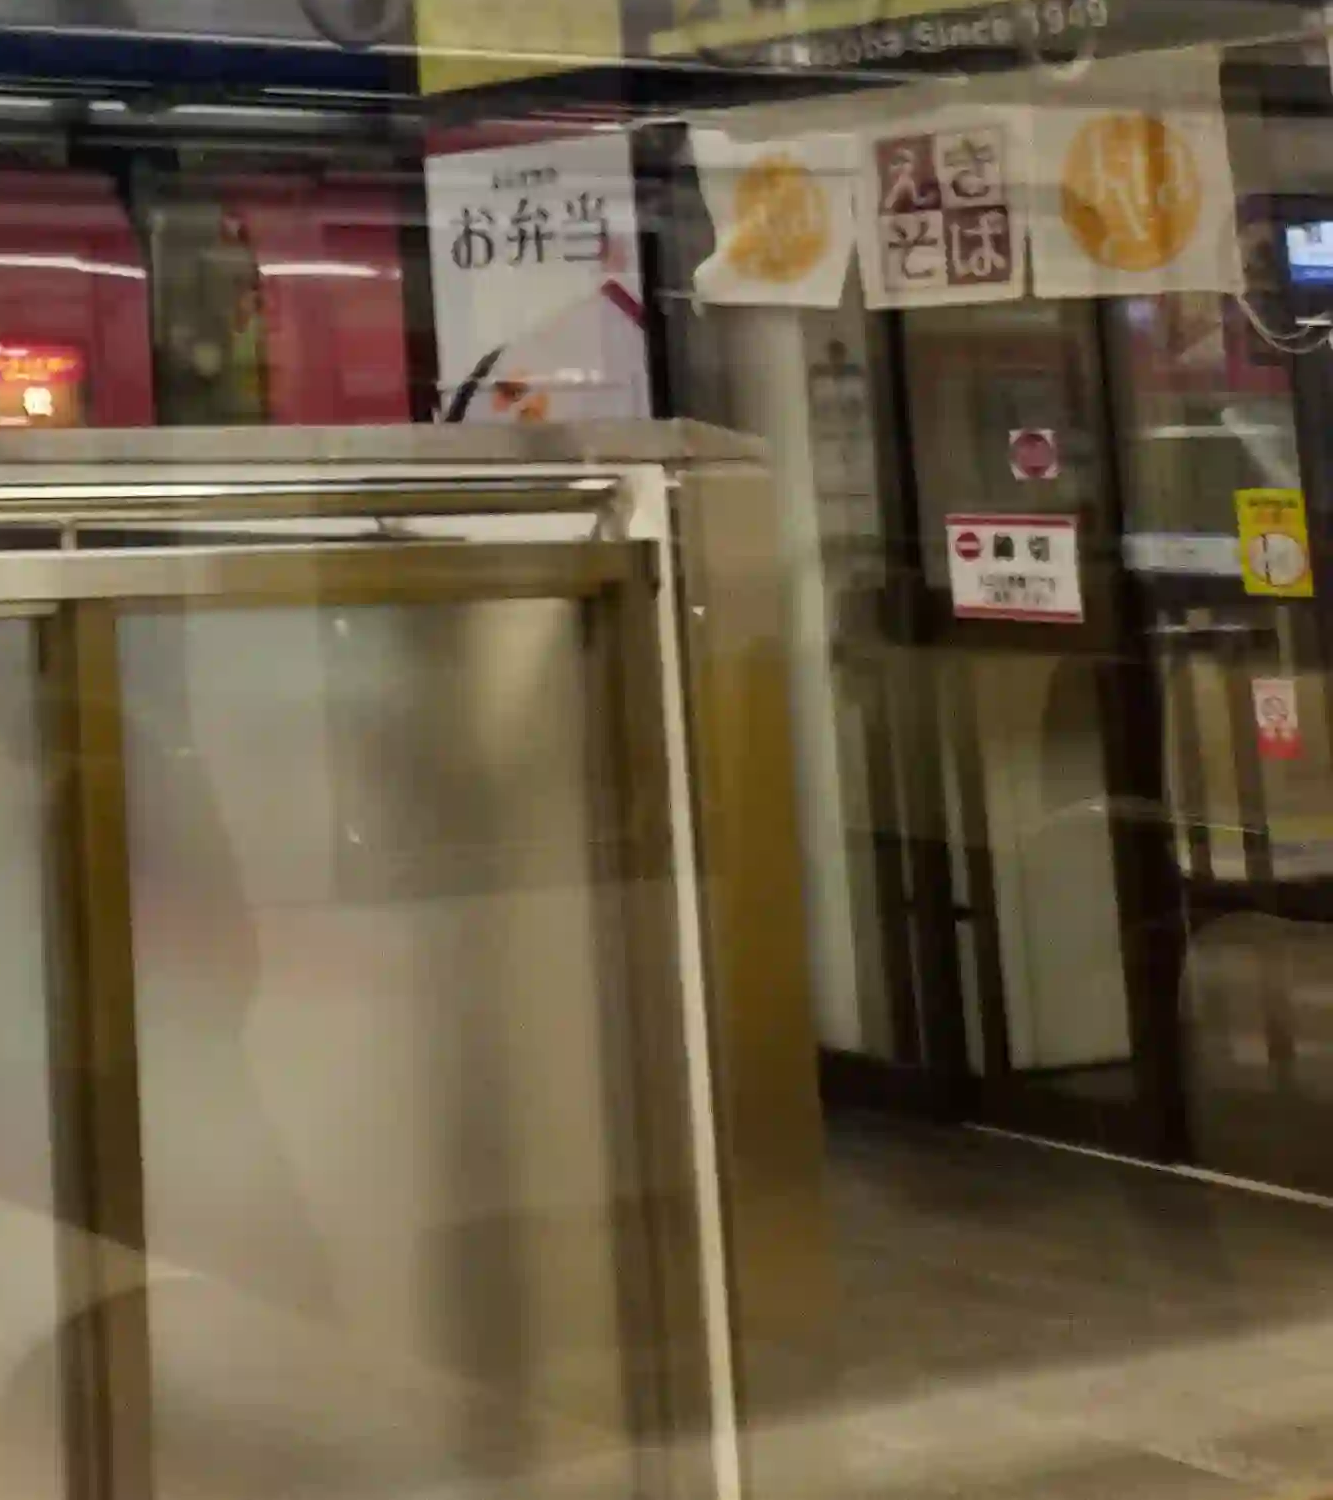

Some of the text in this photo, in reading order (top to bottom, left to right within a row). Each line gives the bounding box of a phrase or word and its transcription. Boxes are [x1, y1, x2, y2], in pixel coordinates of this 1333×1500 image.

[914, 13, 1014, 52] Since
[883, 136, 996, 213] えき
[451, 192, 609, 269] お弁当
[887, 210, 1010, 281] そば
